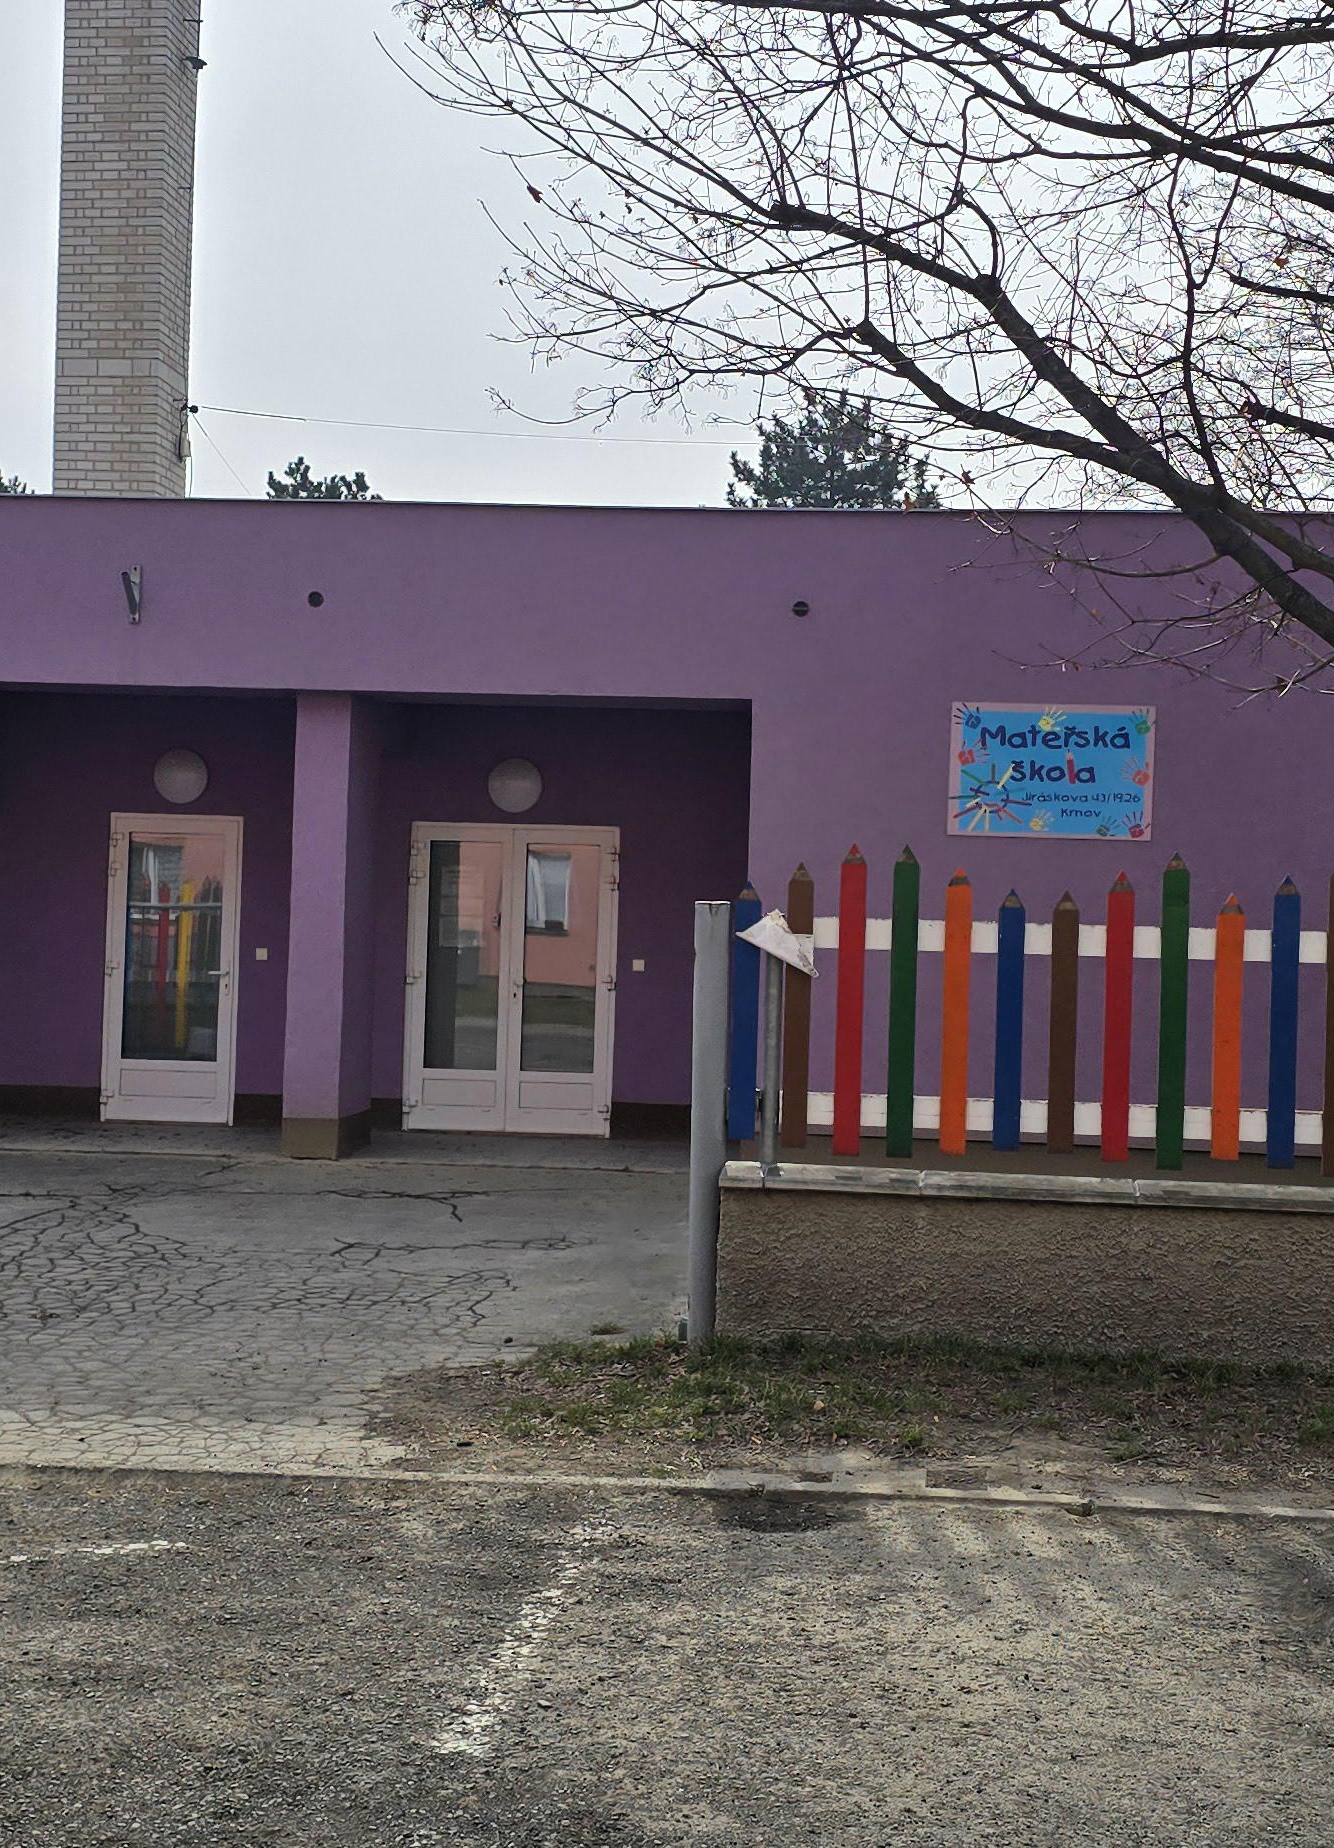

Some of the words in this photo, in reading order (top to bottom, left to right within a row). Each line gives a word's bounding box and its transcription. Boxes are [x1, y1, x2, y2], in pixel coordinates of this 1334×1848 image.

[980, 724, 1131, 749] Mateřská
[1022, 791, 1088, 803] Jiráskova
[1061, 807, 1102, 818] Krnov
